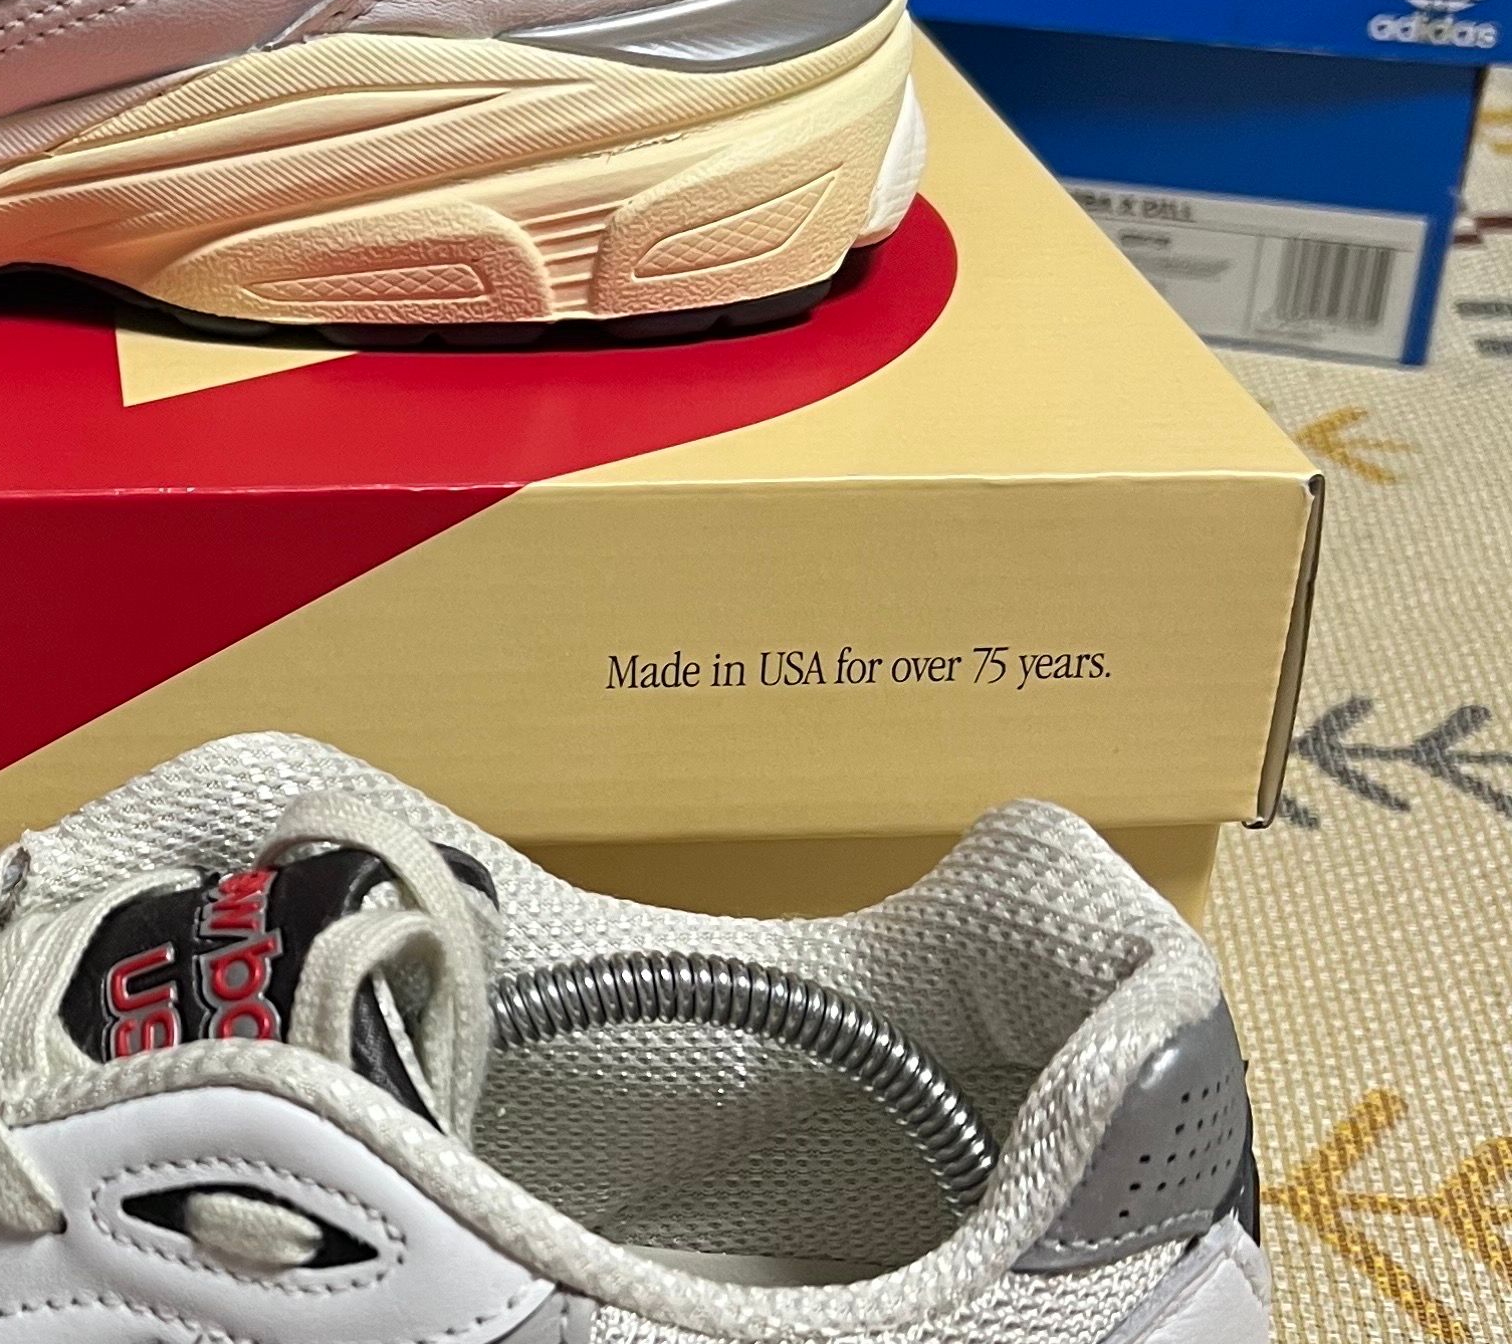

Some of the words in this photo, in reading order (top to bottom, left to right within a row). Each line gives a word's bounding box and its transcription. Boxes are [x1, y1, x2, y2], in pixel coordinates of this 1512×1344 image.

[1366, 12, 1500, 49] adidas
[605, 650, 701, 690] Made
[711, 653, 746, 688] in
[758, 649, 828, 686] USA
[832, 646, 883, 685] for
[890, 653, 962, 683] over
[971, 646, 1009, 685] 75
[1016, 649, 1112, 691] years.
